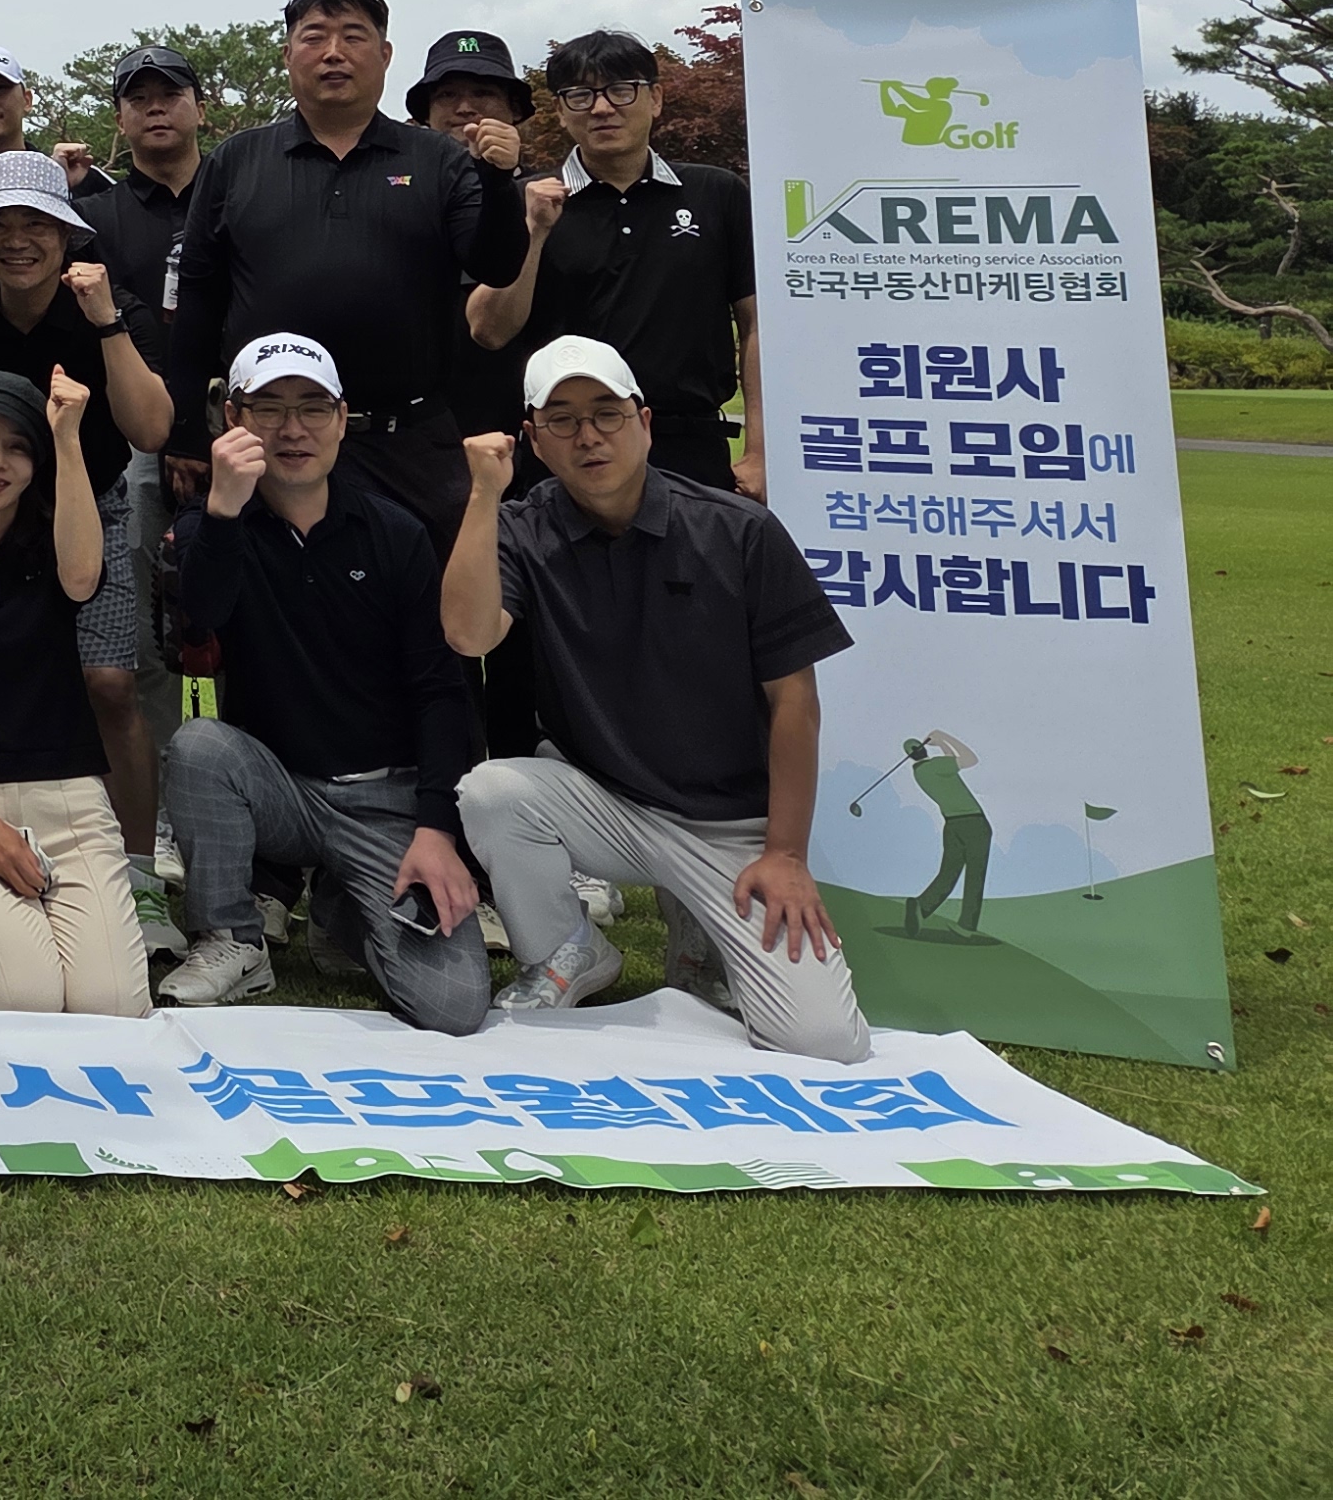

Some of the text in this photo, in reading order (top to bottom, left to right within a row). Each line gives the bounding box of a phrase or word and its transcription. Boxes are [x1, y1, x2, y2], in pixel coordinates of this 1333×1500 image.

[942, 121, 1019, 150] Golf
[784, 179, 1120, 245] KREMA
[785, 269, 1128, 301] 한국부동산마케팅협회
[786, 252, 1123, 267] Korea Real Estate Marketing service Association
[255, 343, 323, 366] SRIXON
[857, 342, 1065, 403] 회원사
[800, 414, 1136, 482] 골프 모임에
[824, 489, 1118, 543] 참석해주셔서
[804, 547, 1156, 624] 감사합니다
